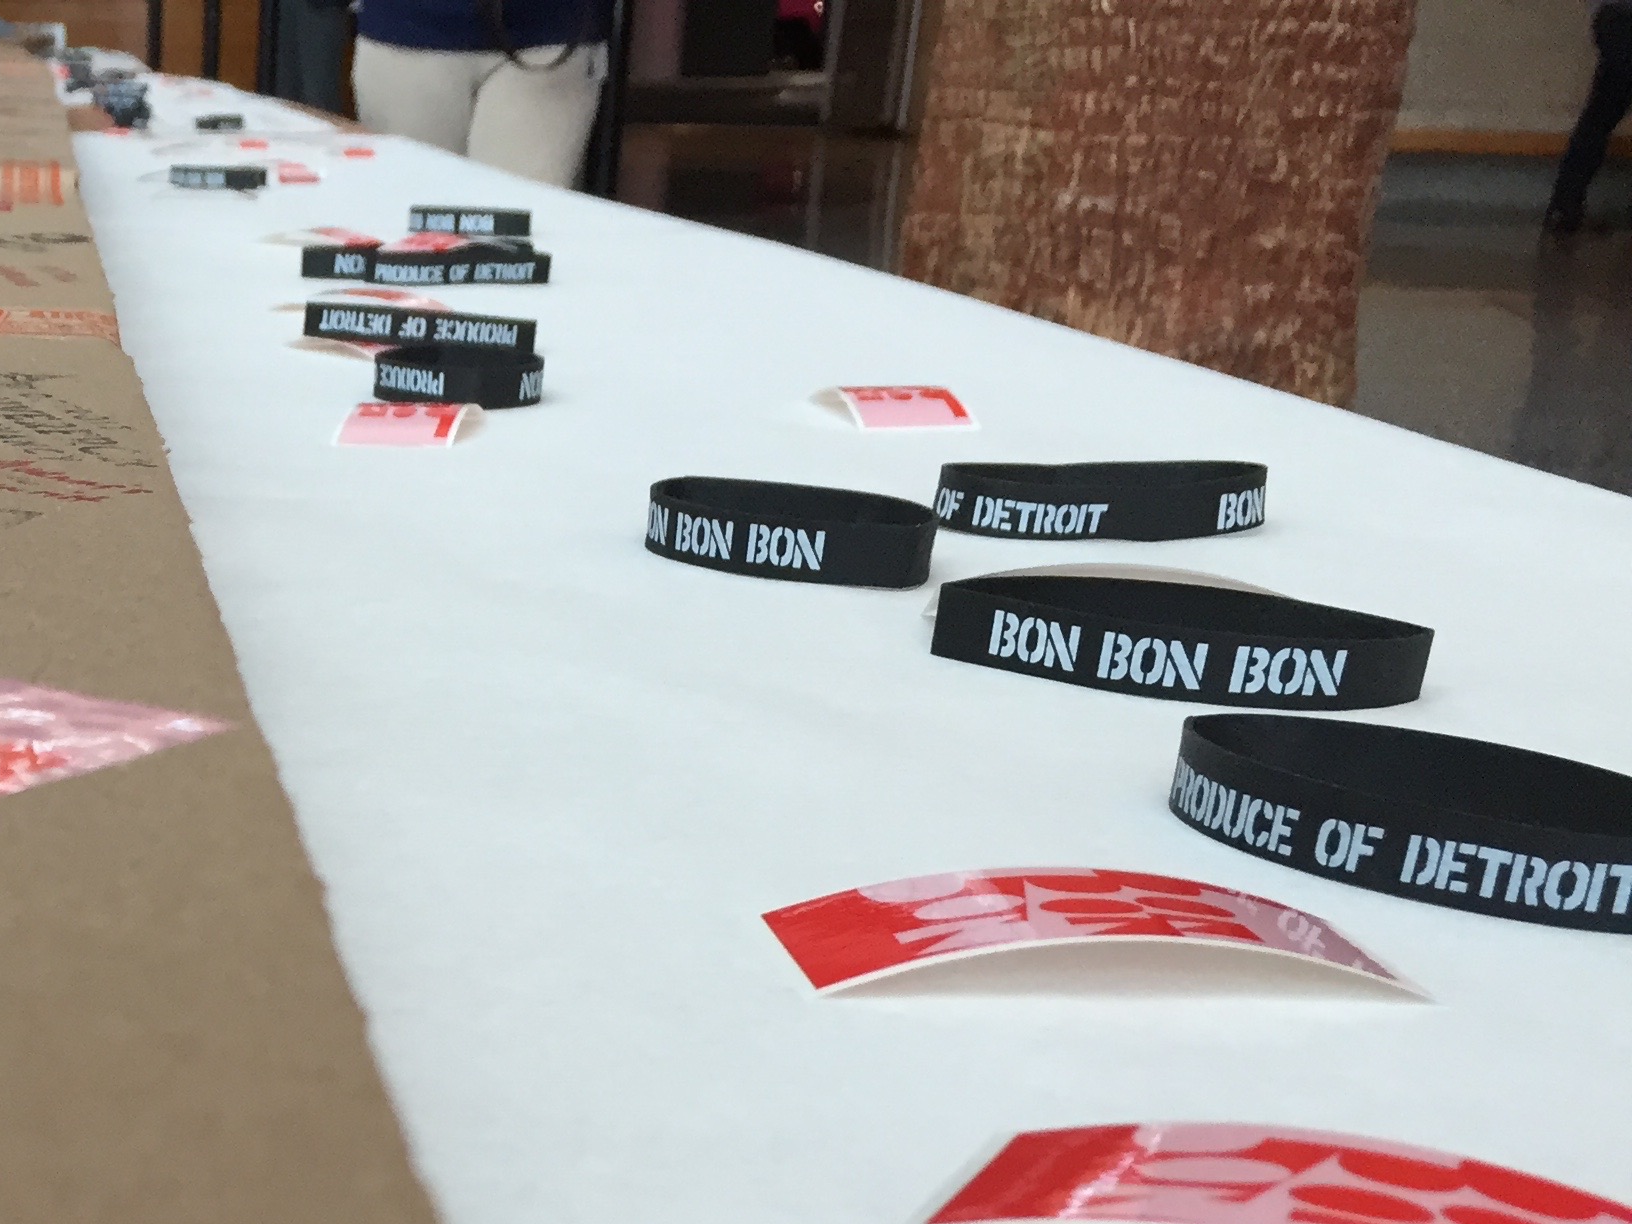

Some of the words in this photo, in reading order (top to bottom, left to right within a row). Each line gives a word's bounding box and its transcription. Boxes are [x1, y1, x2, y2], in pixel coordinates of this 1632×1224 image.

[334, 254, 366, 275] ON
[449, 263, 471, 282] OF
[319, 308, 393, 336] DETROIT
[398, 315, 428, 338] OF
[433, 318, 518, 347] PRODUCE
[380, 364, 445, 396] PRODUCE
[518, 370, 544, 400] ON
[935, 486, 965, 521] OF
[971, 494, 1110, 535] DETROIT
[1216, 486, 1266, 530] BON
[647, 499, 670, 546] ON
[675, 510, 735, 560] BON
[745, 522, 827, 571] BON
[987, 609, 1082, 672] BON
[1096, 630, 1210, 691] BON
[1227, 645, 1349, 697] BON
[1171, 757, 1302, 858] PRODUCE
[1314, 818, 1386, 874] OF
[1398, 834, 1632, 916] DETROIT
